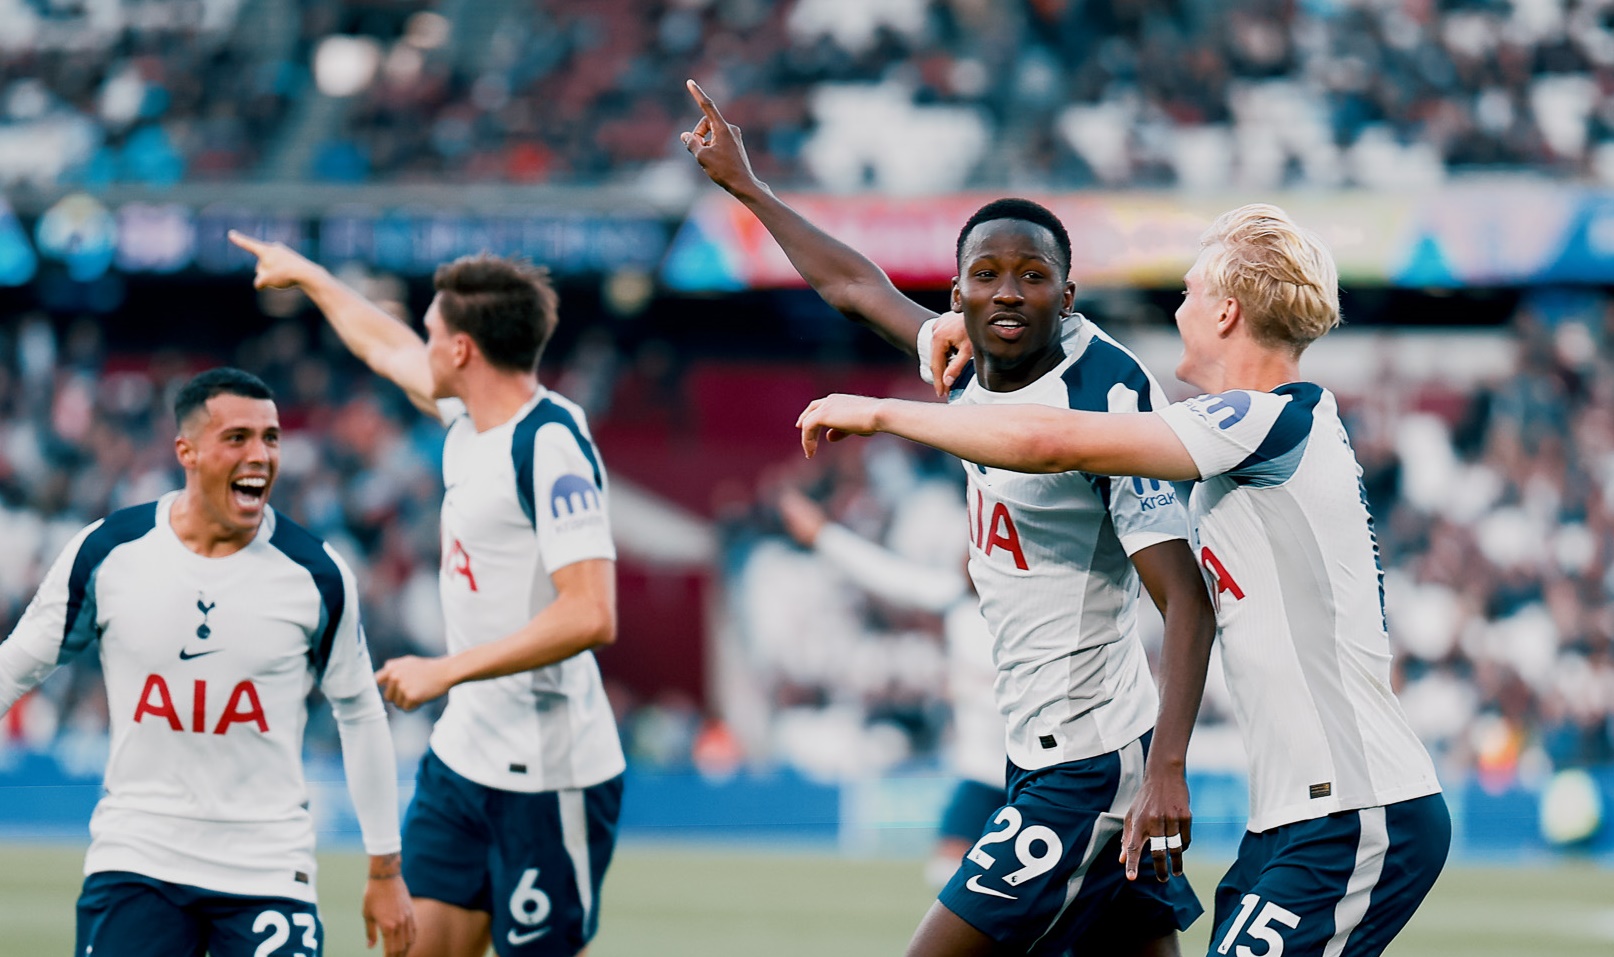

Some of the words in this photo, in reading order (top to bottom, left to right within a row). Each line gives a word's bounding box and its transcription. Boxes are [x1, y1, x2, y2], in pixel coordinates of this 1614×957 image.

[967, 489, 1029, 571] IA
[133, 674, 269, 735] AIA
[967, 806, 1063, 886] 29
[509, 868, 551, 925] 6
[1217, 893, 1301, 957] 15
